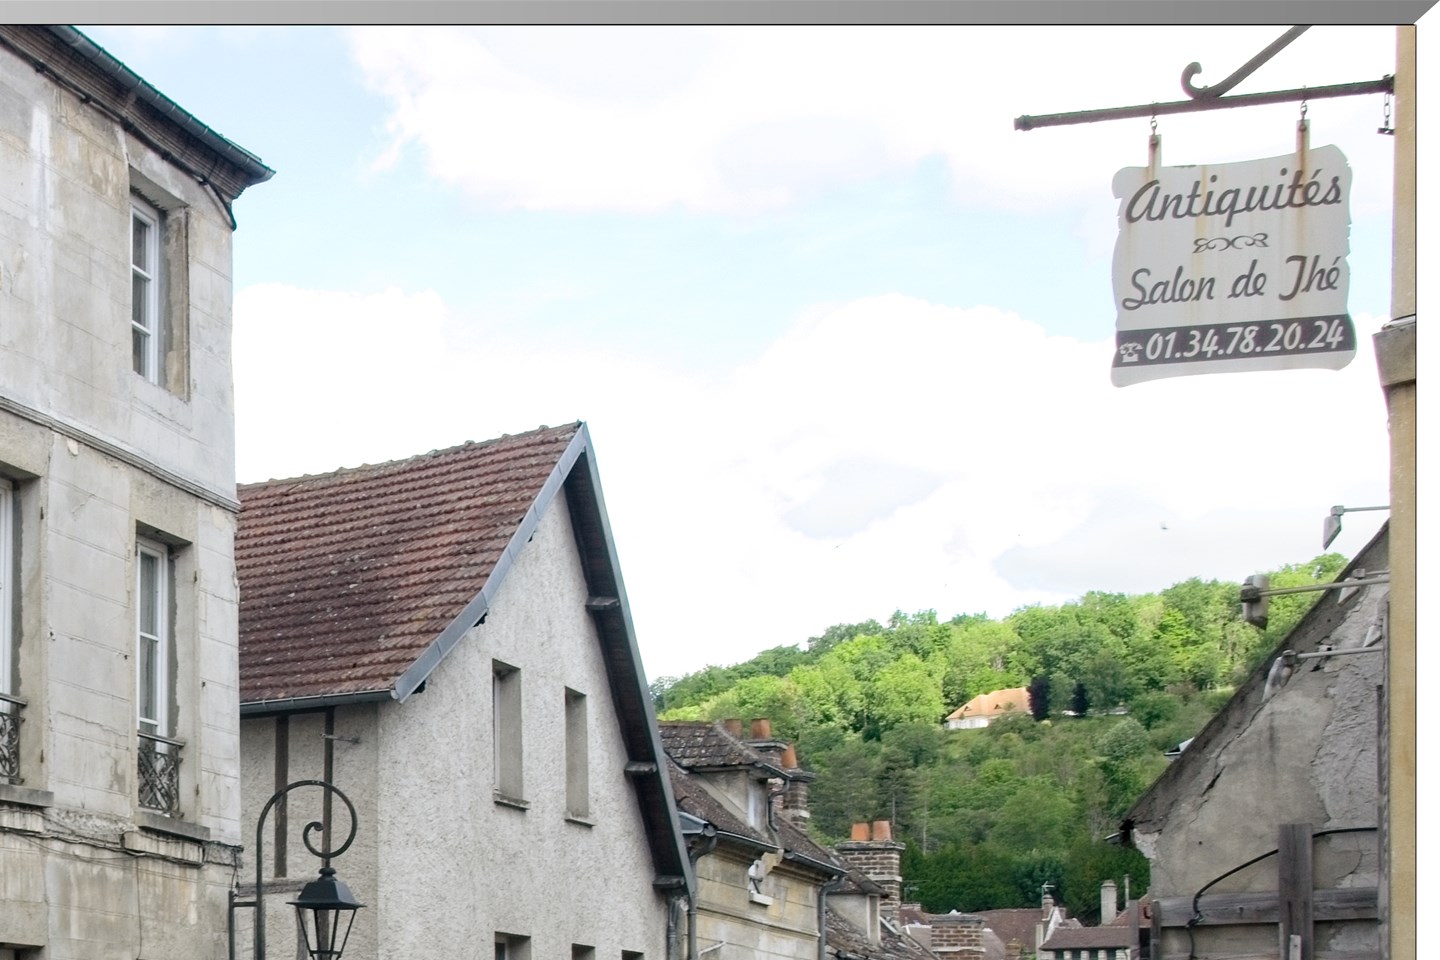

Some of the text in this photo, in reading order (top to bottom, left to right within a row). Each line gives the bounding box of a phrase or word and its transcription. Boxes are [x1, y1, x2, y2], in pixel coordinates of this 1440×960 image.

[1125, 168, 1342, 227] Antiquités
[1122, 255, 1341, 311] Salon de Thé
[1145, 319, 1344, 361] 01.34.78.20.24
